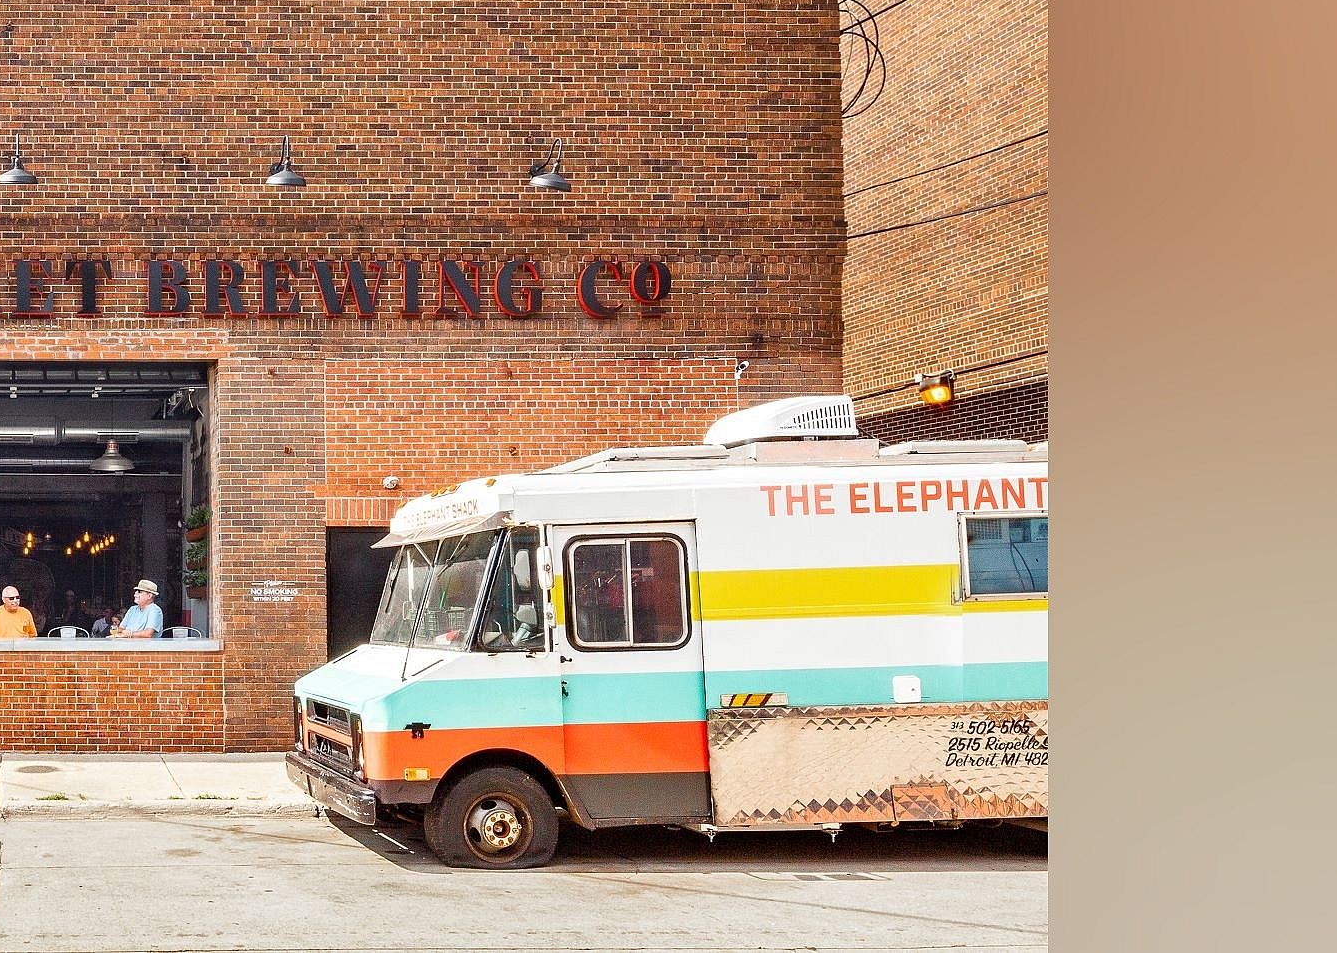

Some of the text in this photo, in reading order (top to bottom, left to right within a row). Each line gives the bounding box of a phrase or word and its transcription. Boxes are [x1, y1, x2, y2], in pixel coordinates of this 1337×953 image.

[143, 259, 546, 319] BREWING
[577, 260, 672, 319] CO
[760, 477, 1048, 516] THE ELEPHANT
[452, 498, 479, 519] SHACK
[950, 721, 964, 730] 313
[948, 737, 982, 751] 2515
[985, 734, 1040, 753] Riopelle
[1000, 752, 1021, 765] MI
